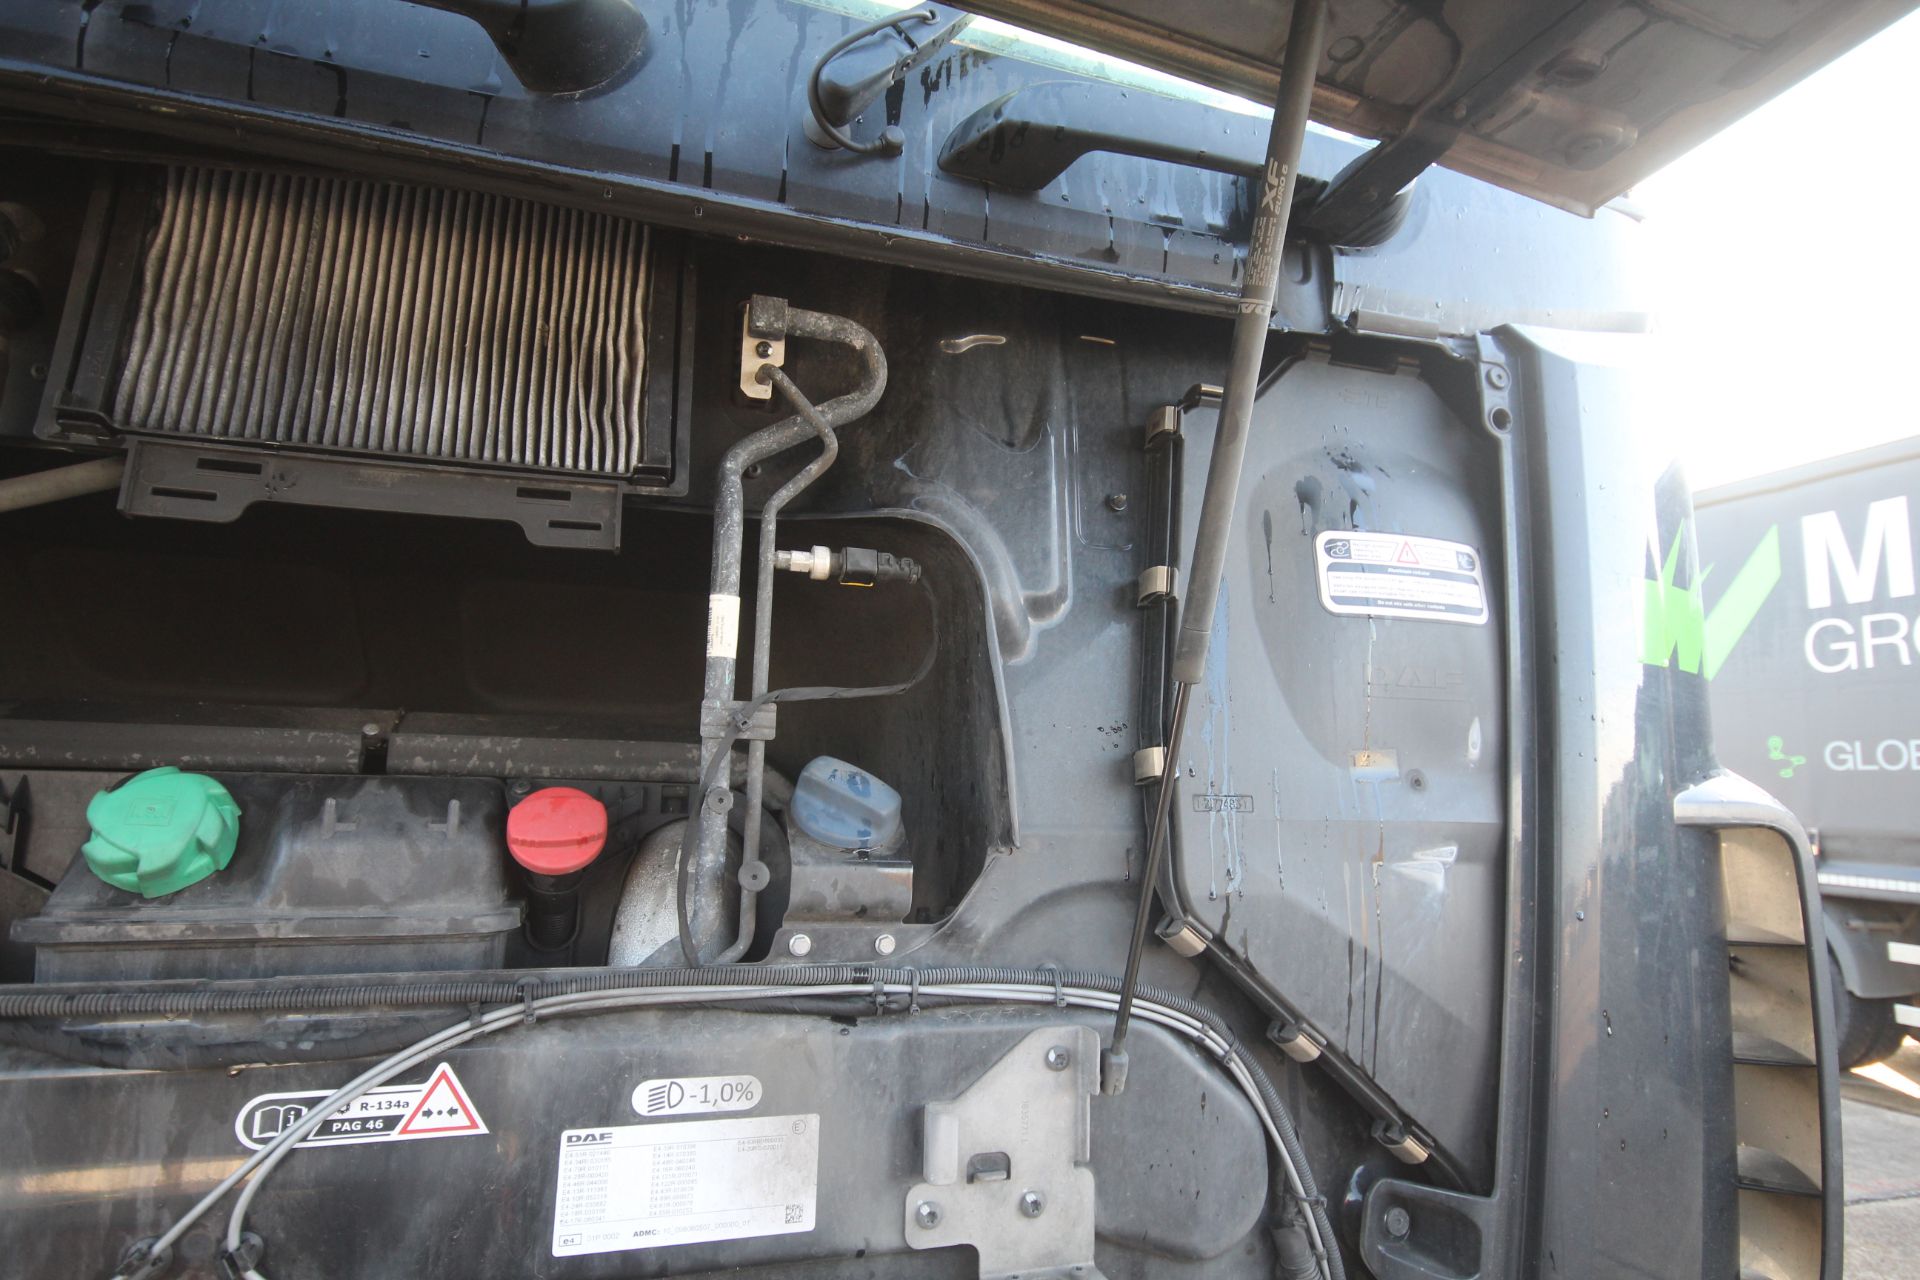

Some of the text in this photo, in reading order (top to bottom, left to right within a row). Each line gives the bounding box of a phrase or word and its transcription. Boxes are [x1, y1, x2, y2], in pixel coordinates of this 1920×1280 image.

[1261, 157, 1279, 212] XF
[689, 1081, 754, 1107] -1,0%
[360, 1100, 410, 1112] R-134a
[332, 1119, 384, 1132] PAG 46
[566, 1132, 613, 1144] DAF
